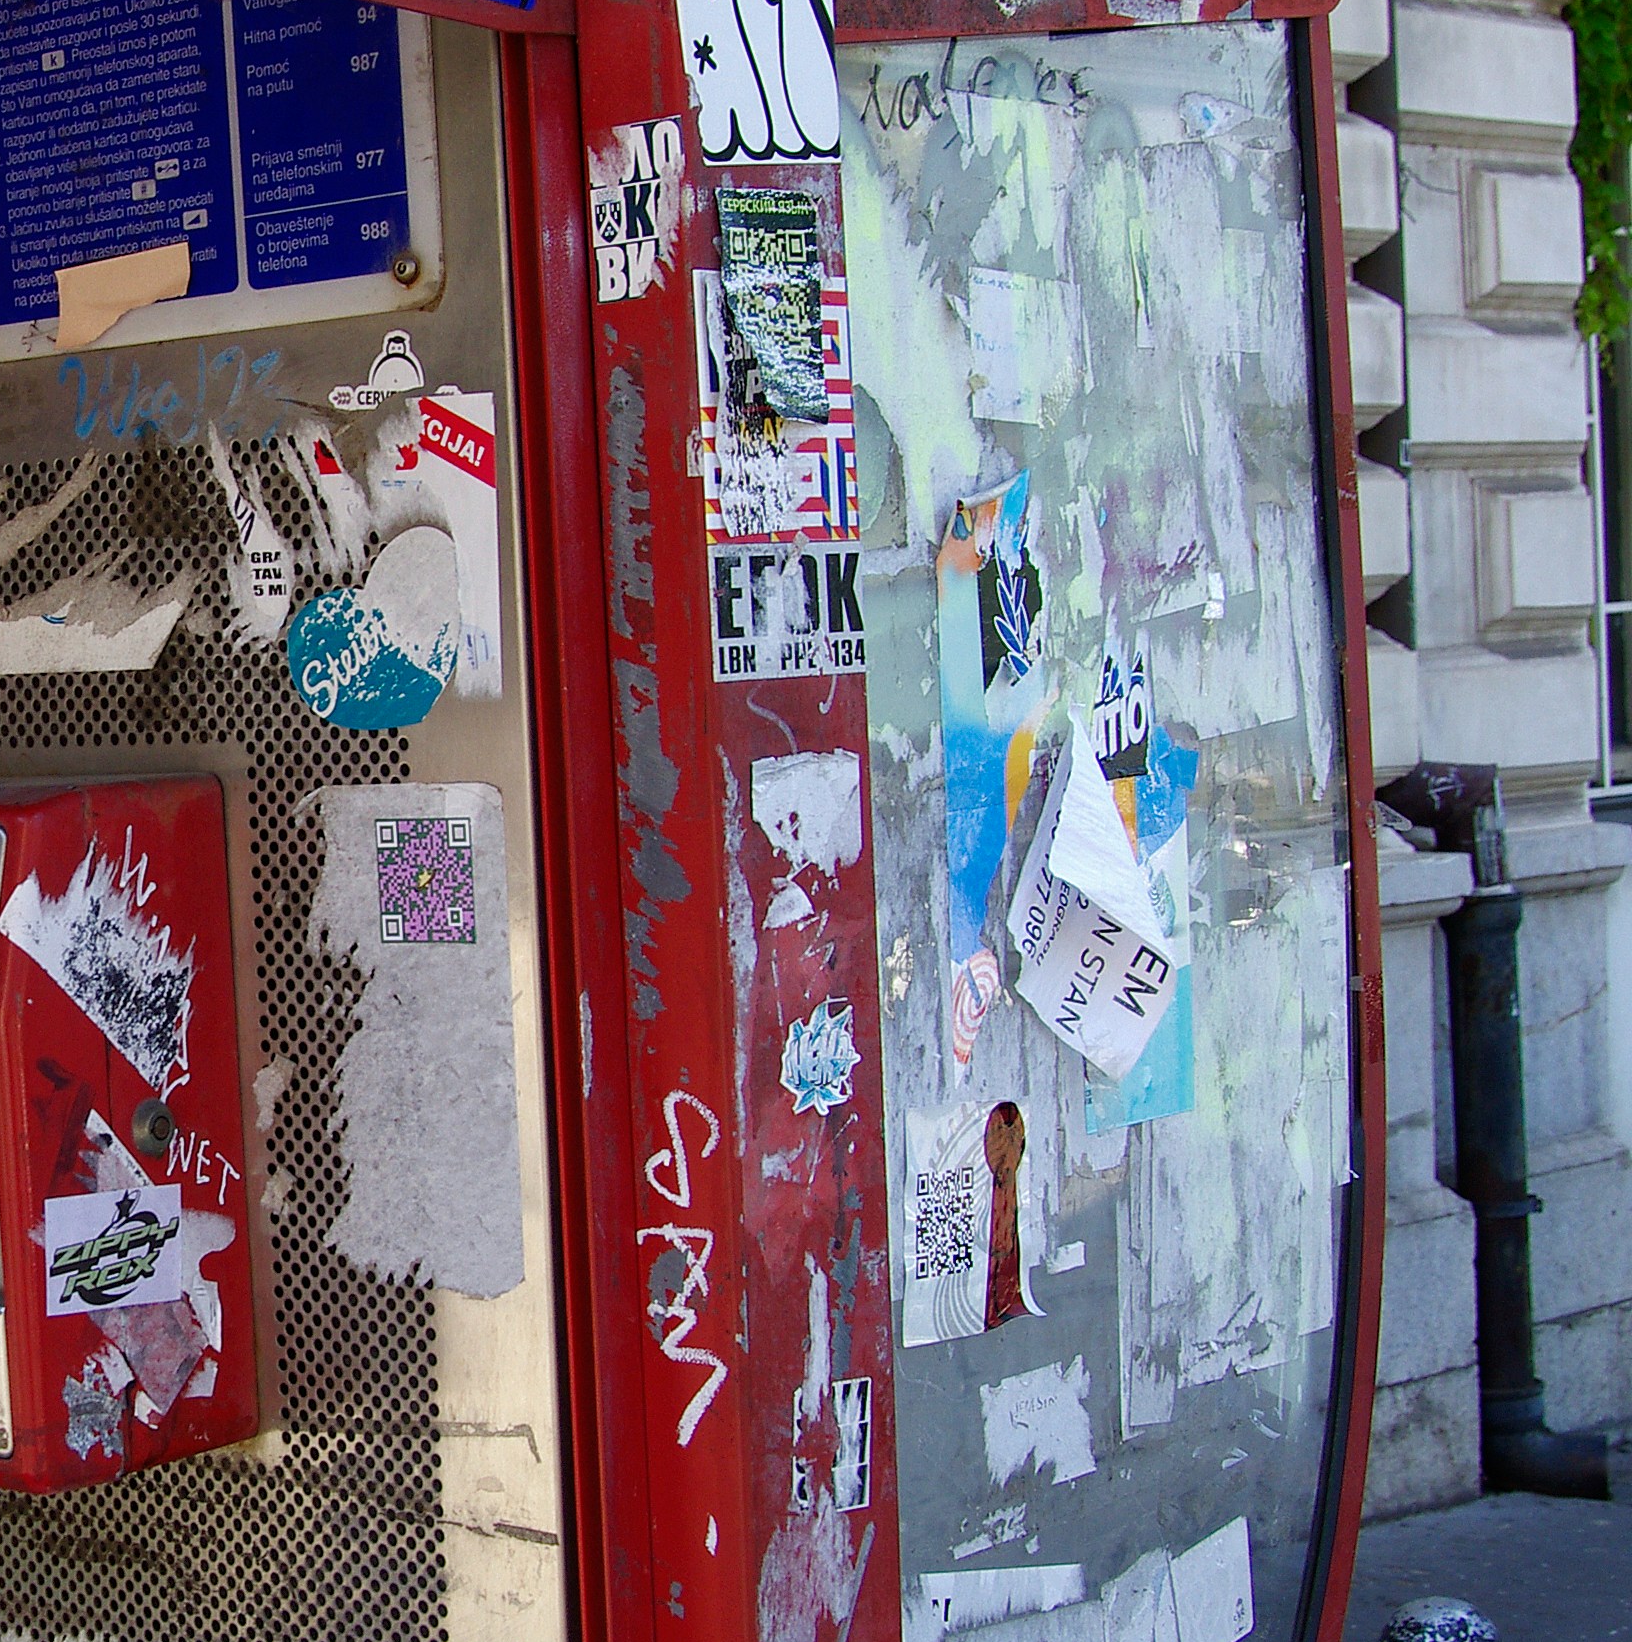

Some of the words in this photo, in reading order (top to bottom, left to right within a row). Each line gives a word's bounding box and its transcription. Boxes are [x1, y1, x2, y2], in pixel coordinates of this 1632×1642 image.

[52, 0, 68, 15] pre
[357, 5, 376, 24] 94
[13, 36, 56, 56] nastavite
[58, 28, 102, 48] razgovor
[111, 18, 138, 36] posle
[141, 14, 154, 27] 30
[119, 36, 146, 51] iznos
[161, 26, 196, 46] potom
[244, 28, 275, 45] Hitna
[280, 17, 322, 42] pomoć
[0, 76, 38, 95] zapisan
[94, 55, 154, 76] telefonskog
[247, 58, 289, 79] Pomoć
[351, 52, 379, 72] 987
[18, 94, 42, 109] Vam
[122, 69, 170, 89] zamenite
[173, 64, 201, 78] staru
[248, 85, 263, 97] na
[267, 79, 294, 97] putu
[2, 113, 35, 131] karticu
[37, 109, 70, 124] novom
[157, 80, 206, 102] prekidate
[4, 129, 46, 149] razgovor
[58, 119, 99, 137] dodatno
[6, 149, 46, 166] Jednom
[94, 132, 128, 149] kartica
[252, 151, 293, 168] Prijava
[298, 140, 342, 160] smetnji
[356, 149, 384, 169] 977
[7, 182, 39, 202] biranje
[42, 177, 73, 196] novog
[106, 166, 148, 185] pritisnite
[253, 174, 268, 185] na
[272, 159, 343, 183] telefonskim
[8, 200, 50, 221] ponovno
[53, 192, 86, 212] biranje
[256, 213, 334, 237] Obaveštenje
[361, 221, 389, 241] 988
[257, 244, 265, 254] o
[269, 234, 329, 254] brojevima
[12, 253, 47, 272] Ukoliko
[258, 255, 307, 272] telefona
[50, 1216, 179, 1277] ZIPPY
[60, 1250, 160, 1303] ROX
